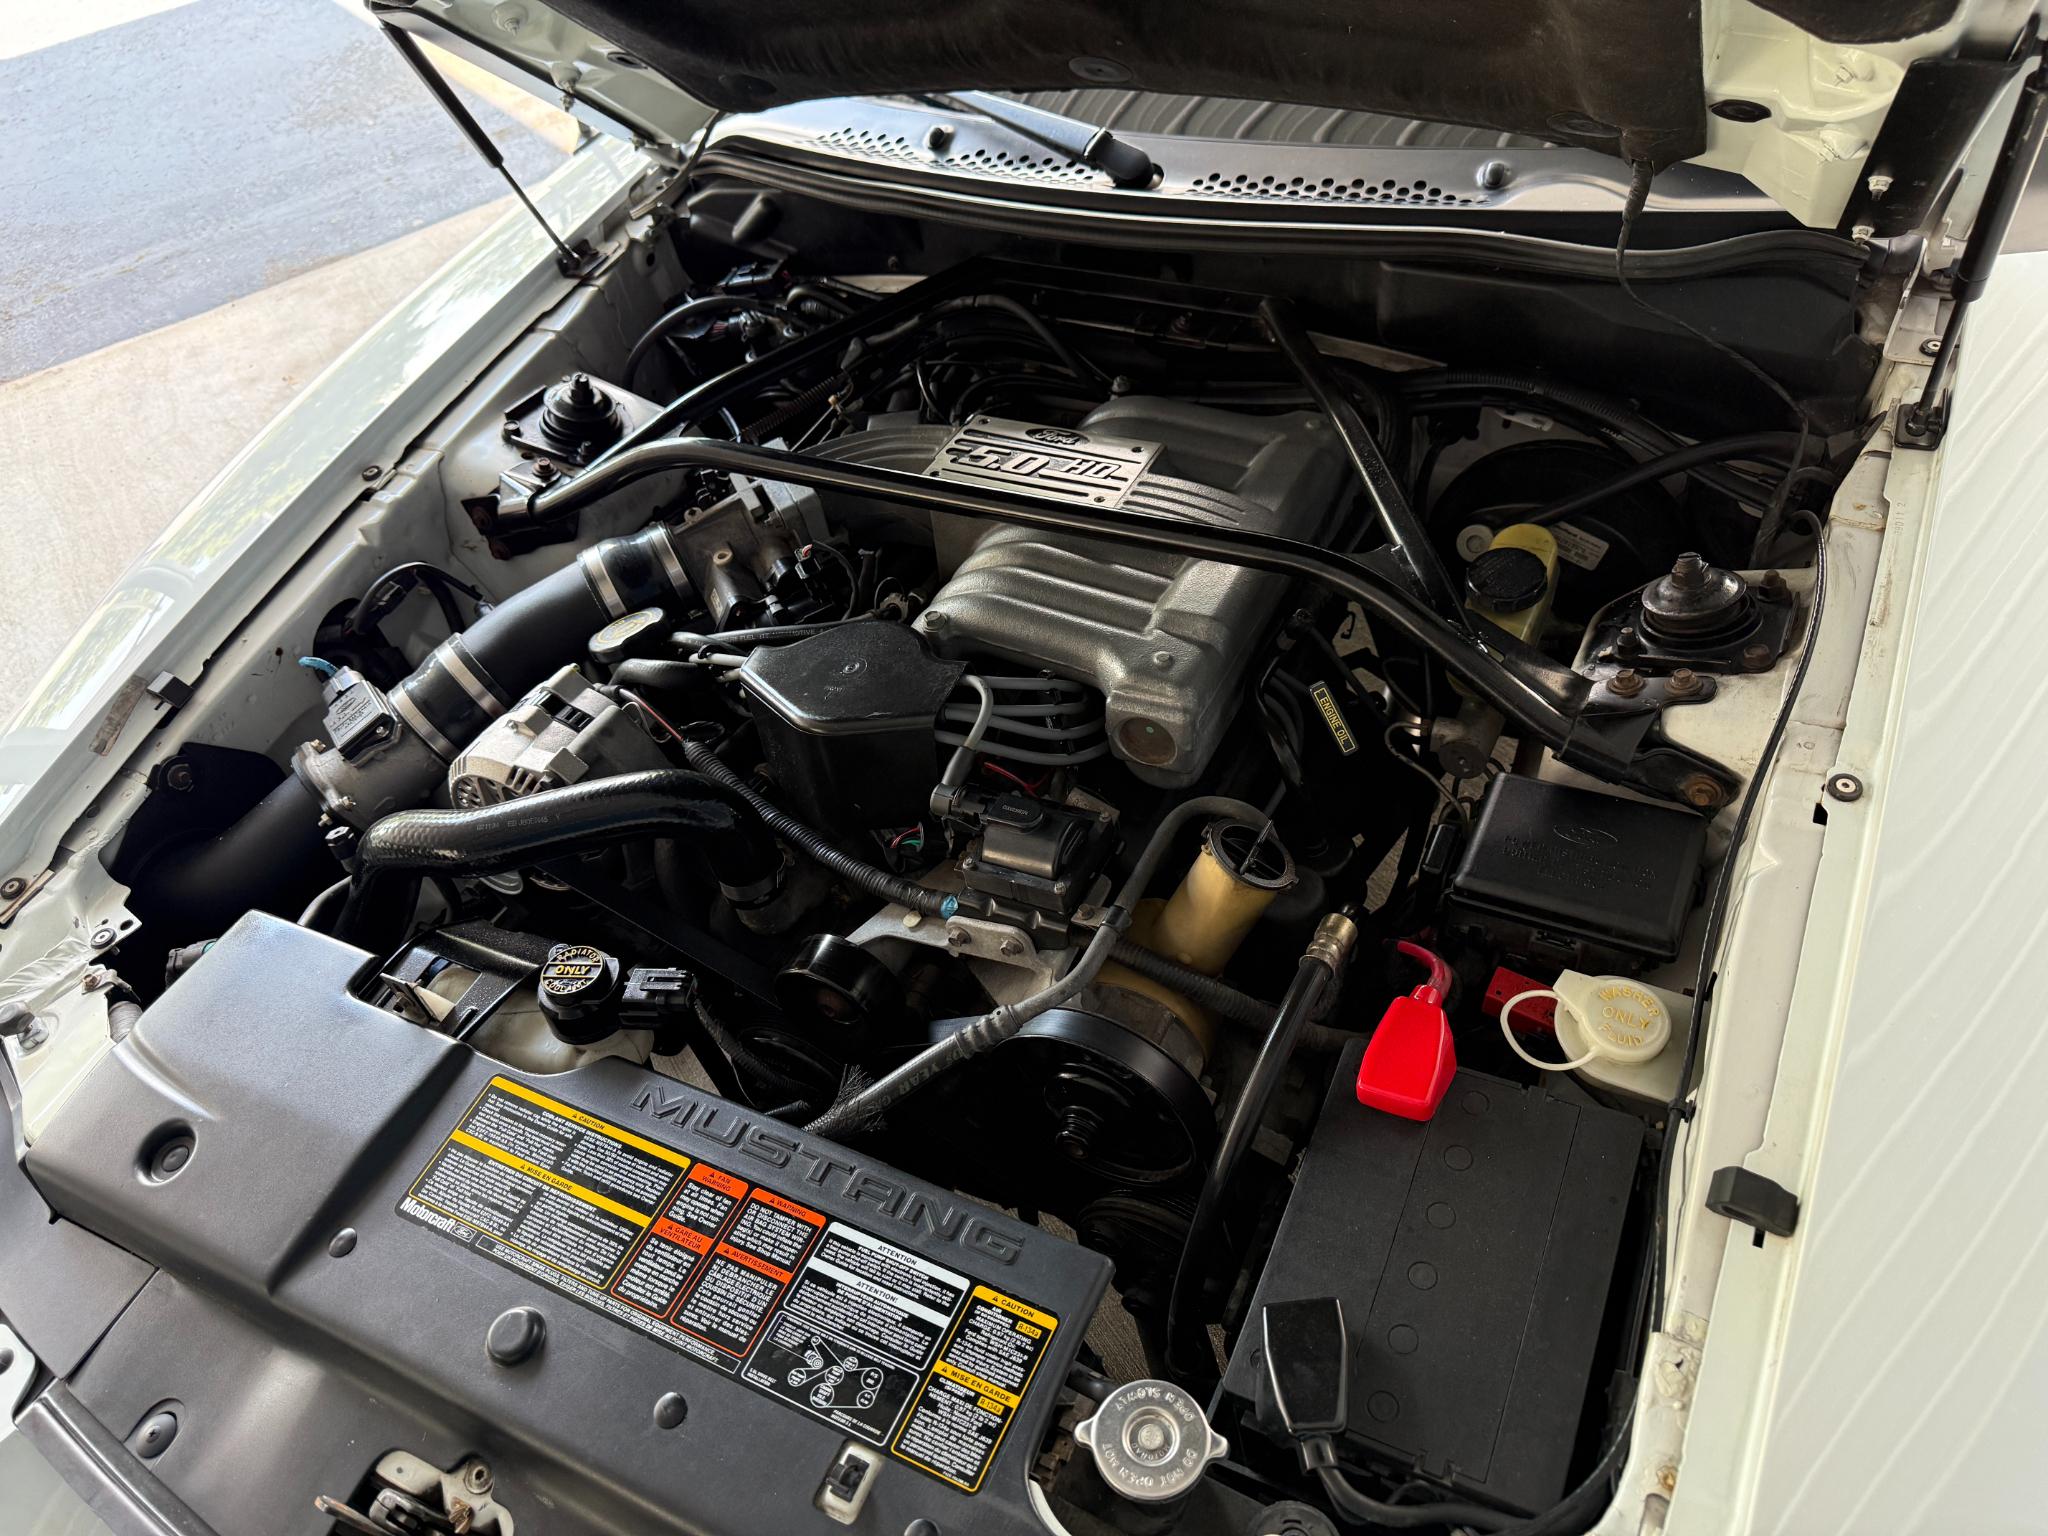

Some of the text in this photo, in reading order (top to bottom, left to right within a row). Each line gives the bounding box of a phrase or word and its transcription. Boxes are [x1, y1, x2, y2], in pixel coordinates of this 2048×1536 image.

[1035, 428, 1080, 446] Ford
[957, 445, 1050, 477] 5.0
[1320, 696, 1350, 744] ENGINE OIL
[556, 948, 601, 963] RADIATOR
[555, 965, 591, 976] ONLY
[544, 978, 588, 992] COOLANT
[1598, 985, 1660, 1017] WASHER
[1602, 1006, 1651, 1031] ONLY
[1598, 1023, 1644, 1047] FLUID
[579, 1116, 605, 1130] CAUTION
[527, 1167, 542, 1177] MISE
[551, 1178, 572, 1191] GARDE
[630, 1082, 1026, 1266] MUSTANG
[702, 1176, 731, 1191] WARNING
[718, 1175, 731, 1184] FAN
[687, 1182, 701, 1192] Stay
[700, 1189, 715, 1198] clear
[722, 1197, 732, 1206] fan
[400, 1197, 456, 1233] Motorcraft
[676, 1200, 695, 1211] engine
[699, 1210, 710, 1218] not
[716, 1202, 728, 1211] Fan
[777, 1200, 806, 1217] WARNING
[686, 1211, 698, 1220] See
[698, 1216, 717, 1228] Owner
[747, 1208, 809, 1239] OR DISCONNECT THE
[750, 1202, 812, 1233] DO NOT TAMPER WITH
[675, 1227, 703, 1243] GARE AU
[753, 1224, 763, 1232] You
[754, 1218, 767, 1227] BAG
[767, 1224, 791, 1237] SYSTEM
[650, 1237, 659, 1246] Se
[660, 1228, 701, 1250] VENTILATEUR
[745, 1241, 757, 1250] See
[731, 1251, 783, 1276] AVERTISSEMENT
[878, 1245, 917, 1265] ATTENTION
[712, 1264, 720, 1272] NI
[765, 1288, 775, 1296] LE
[715, 1258, 777, 1290] NE PAS MANIPULER
[698, 1286, 712, 1297] Cela
[701, 1281, 727, 1296] COUSSIN
[726, 1292, 736, 1300] DE
[705, 1275, 715, 1283] DU
[716, 1280, 751, 1298] DISPOSITIF
[1001, 1299, 1034, 1317] CAUTION
[1018, 1323, 1039, 1337] R-134a
[951, 1370, 970, 1383] MISE
[971, 1380, 982, 1389] EN
[983, 1386, 1011, 1402] GARDE
[979, 1398, 1001, 1413] R-134a
